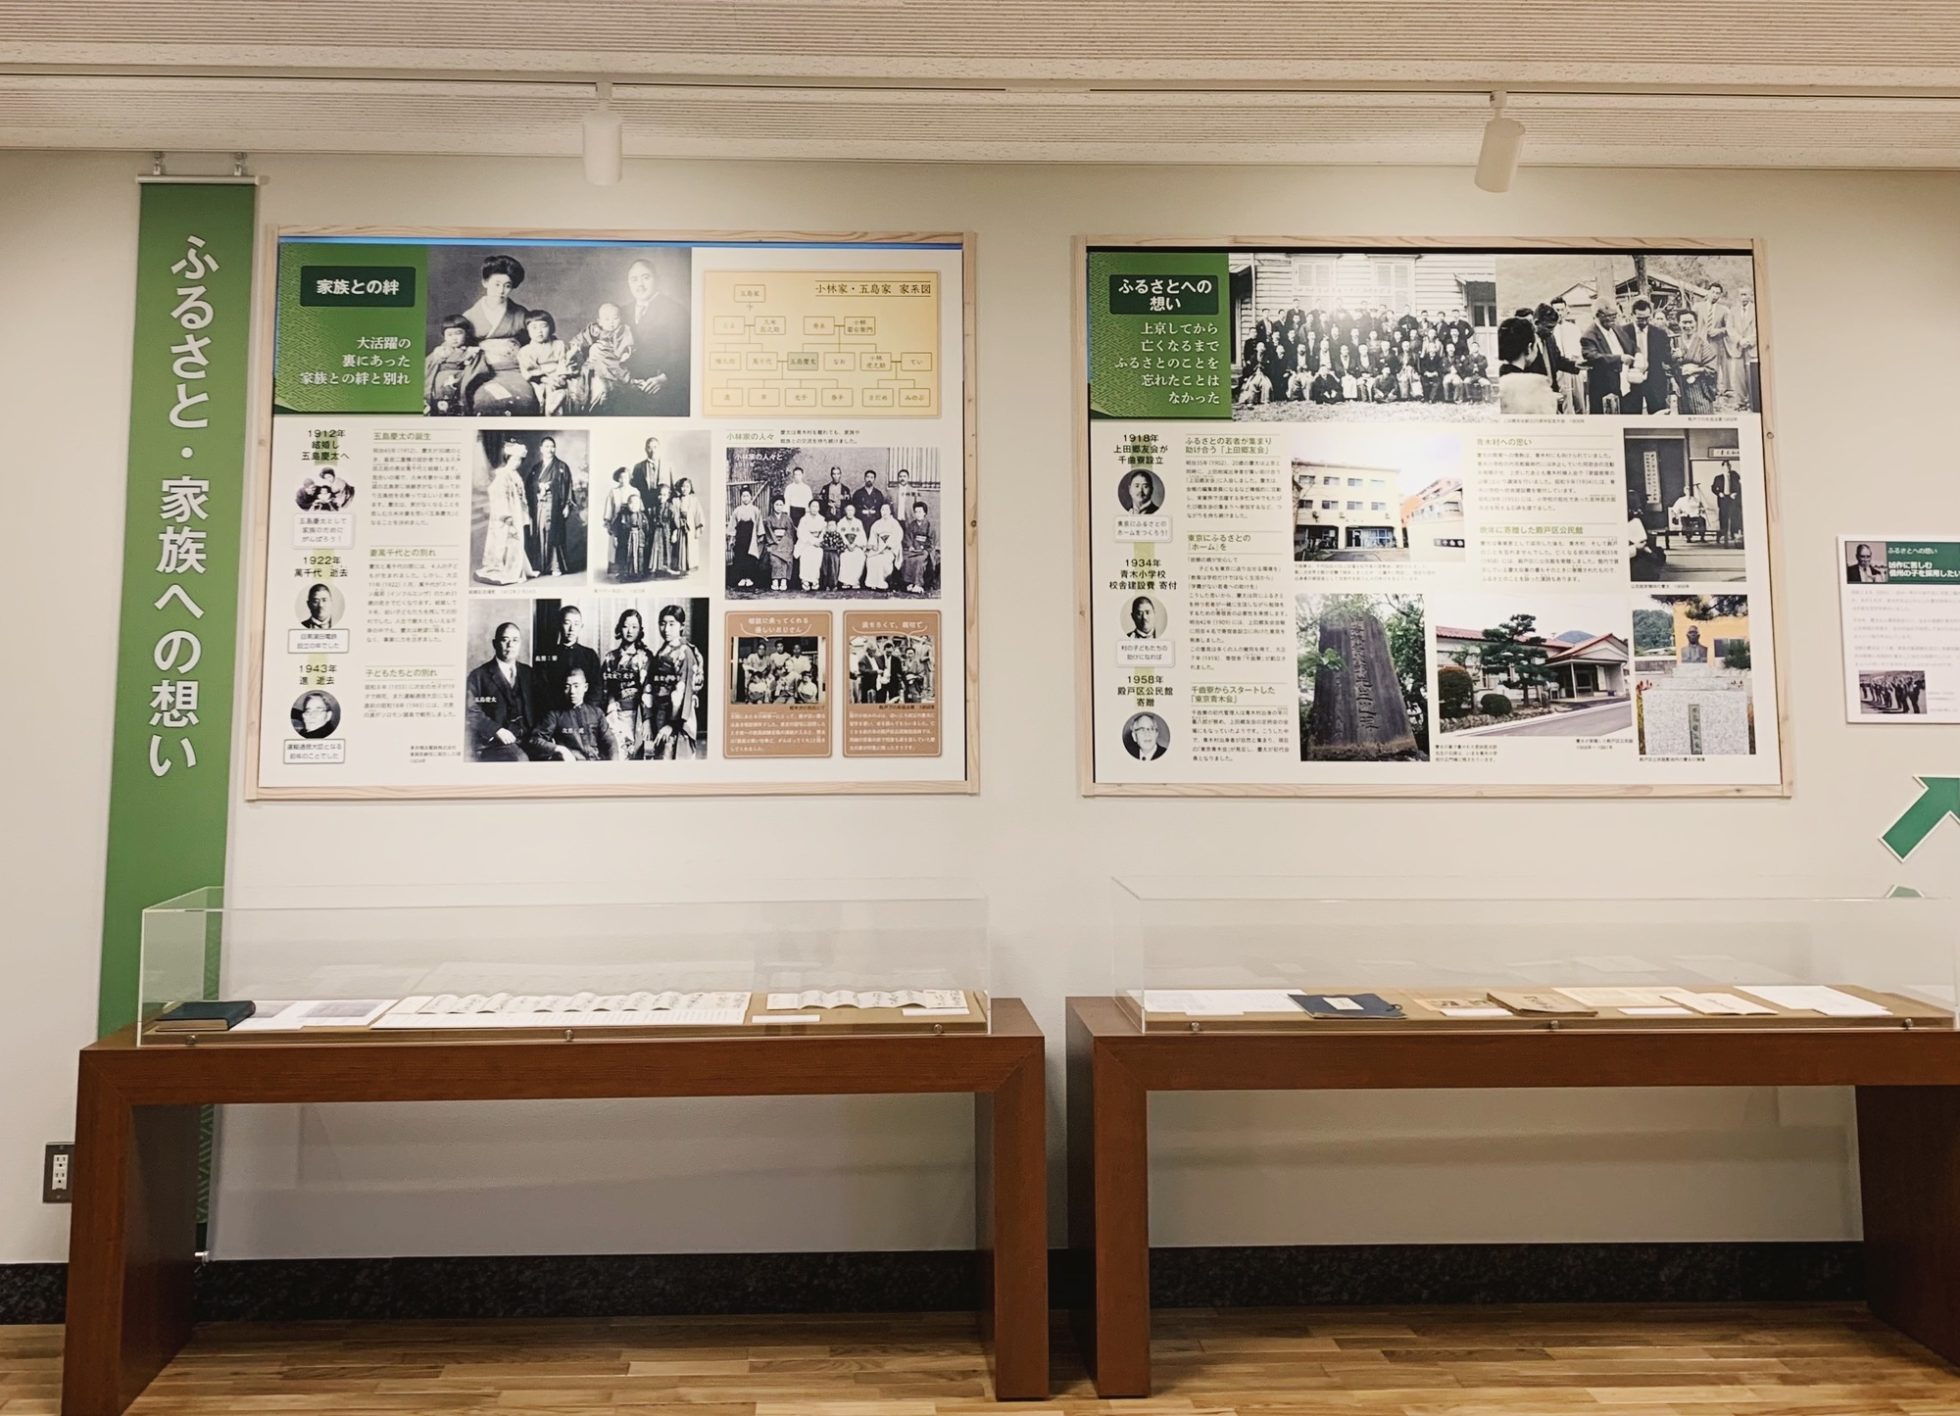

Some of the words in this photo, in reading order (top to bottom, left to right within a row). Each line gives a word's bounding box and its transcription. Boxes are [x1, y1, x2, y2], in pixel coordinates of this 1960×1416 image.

[316, 278, 400, 296] 家族との絆
[815, 283, 892, 295] 小林家・五島家
[898, 283, 931, 295] 家系図
[1118, 279, 1212, 294] ふるさとへの
[1150, 297, 1181, 311] 想い
[1141, 322, 1218, 335] 上京してから
[356, 336, 411, 351] 大活躍の
[1141, 339, 1220, 352] 亡くなるまで
[342, 353, 411, 368] 裏にあった
[1115, 357, 1219, 369] ふるさとのことを
[300, 371, 411, 386] 家族との絆と別れ
[1141, 375, 1220, 387] 忘れたことは
[1168, 391, 1220, 404] なかった
[307, 429, 346, 438] 1912年
[373, 431, 431, 441] 五島慶太の誕生
[726, 432, 775, 442] 小林家の人々
[1123, 434, 1159, 442] 1918年
[312, 441, 339, 450] 結婚し
[1185, 437, 1272, 445] ふるさとの若者が集まり
[1113, 445, 1168, 454] 上田郷友会が
[1185, 446, 1270, 455] 助け合う「上田郷友会」
[302, 452, 350, 461] 五島慶太へ
[1118, 456, 1163, 465] 千曲寮設立
[148, 236, 219, 777] ふるさと・家族への想い
[1188, 534, 1251, 542] 東京にふるさとの
[303, 556, 342, 565] 1922年
[1125, 559, 1161, 568] 1934年
[1120, 570, 1166, 579] 青木小学校
[1109, 581, 1155, 590] 校舎建設費
[1159, 581, 1177, 590] 寄付
[299, 664, 337, 674] 1943年
[365, 669, 437, 678] 子どもたちとの別れ
[1127, 675, 1163, 684] 1958年
[1117, 687, 1173, 696] 殿戸区公民館
[1191, 686, 1275, 695] 千曲寮からスタートした
[1136, 698, 1154, 707] 寄贈
[1191, 695, 1238, 704] 「東京青木会」
